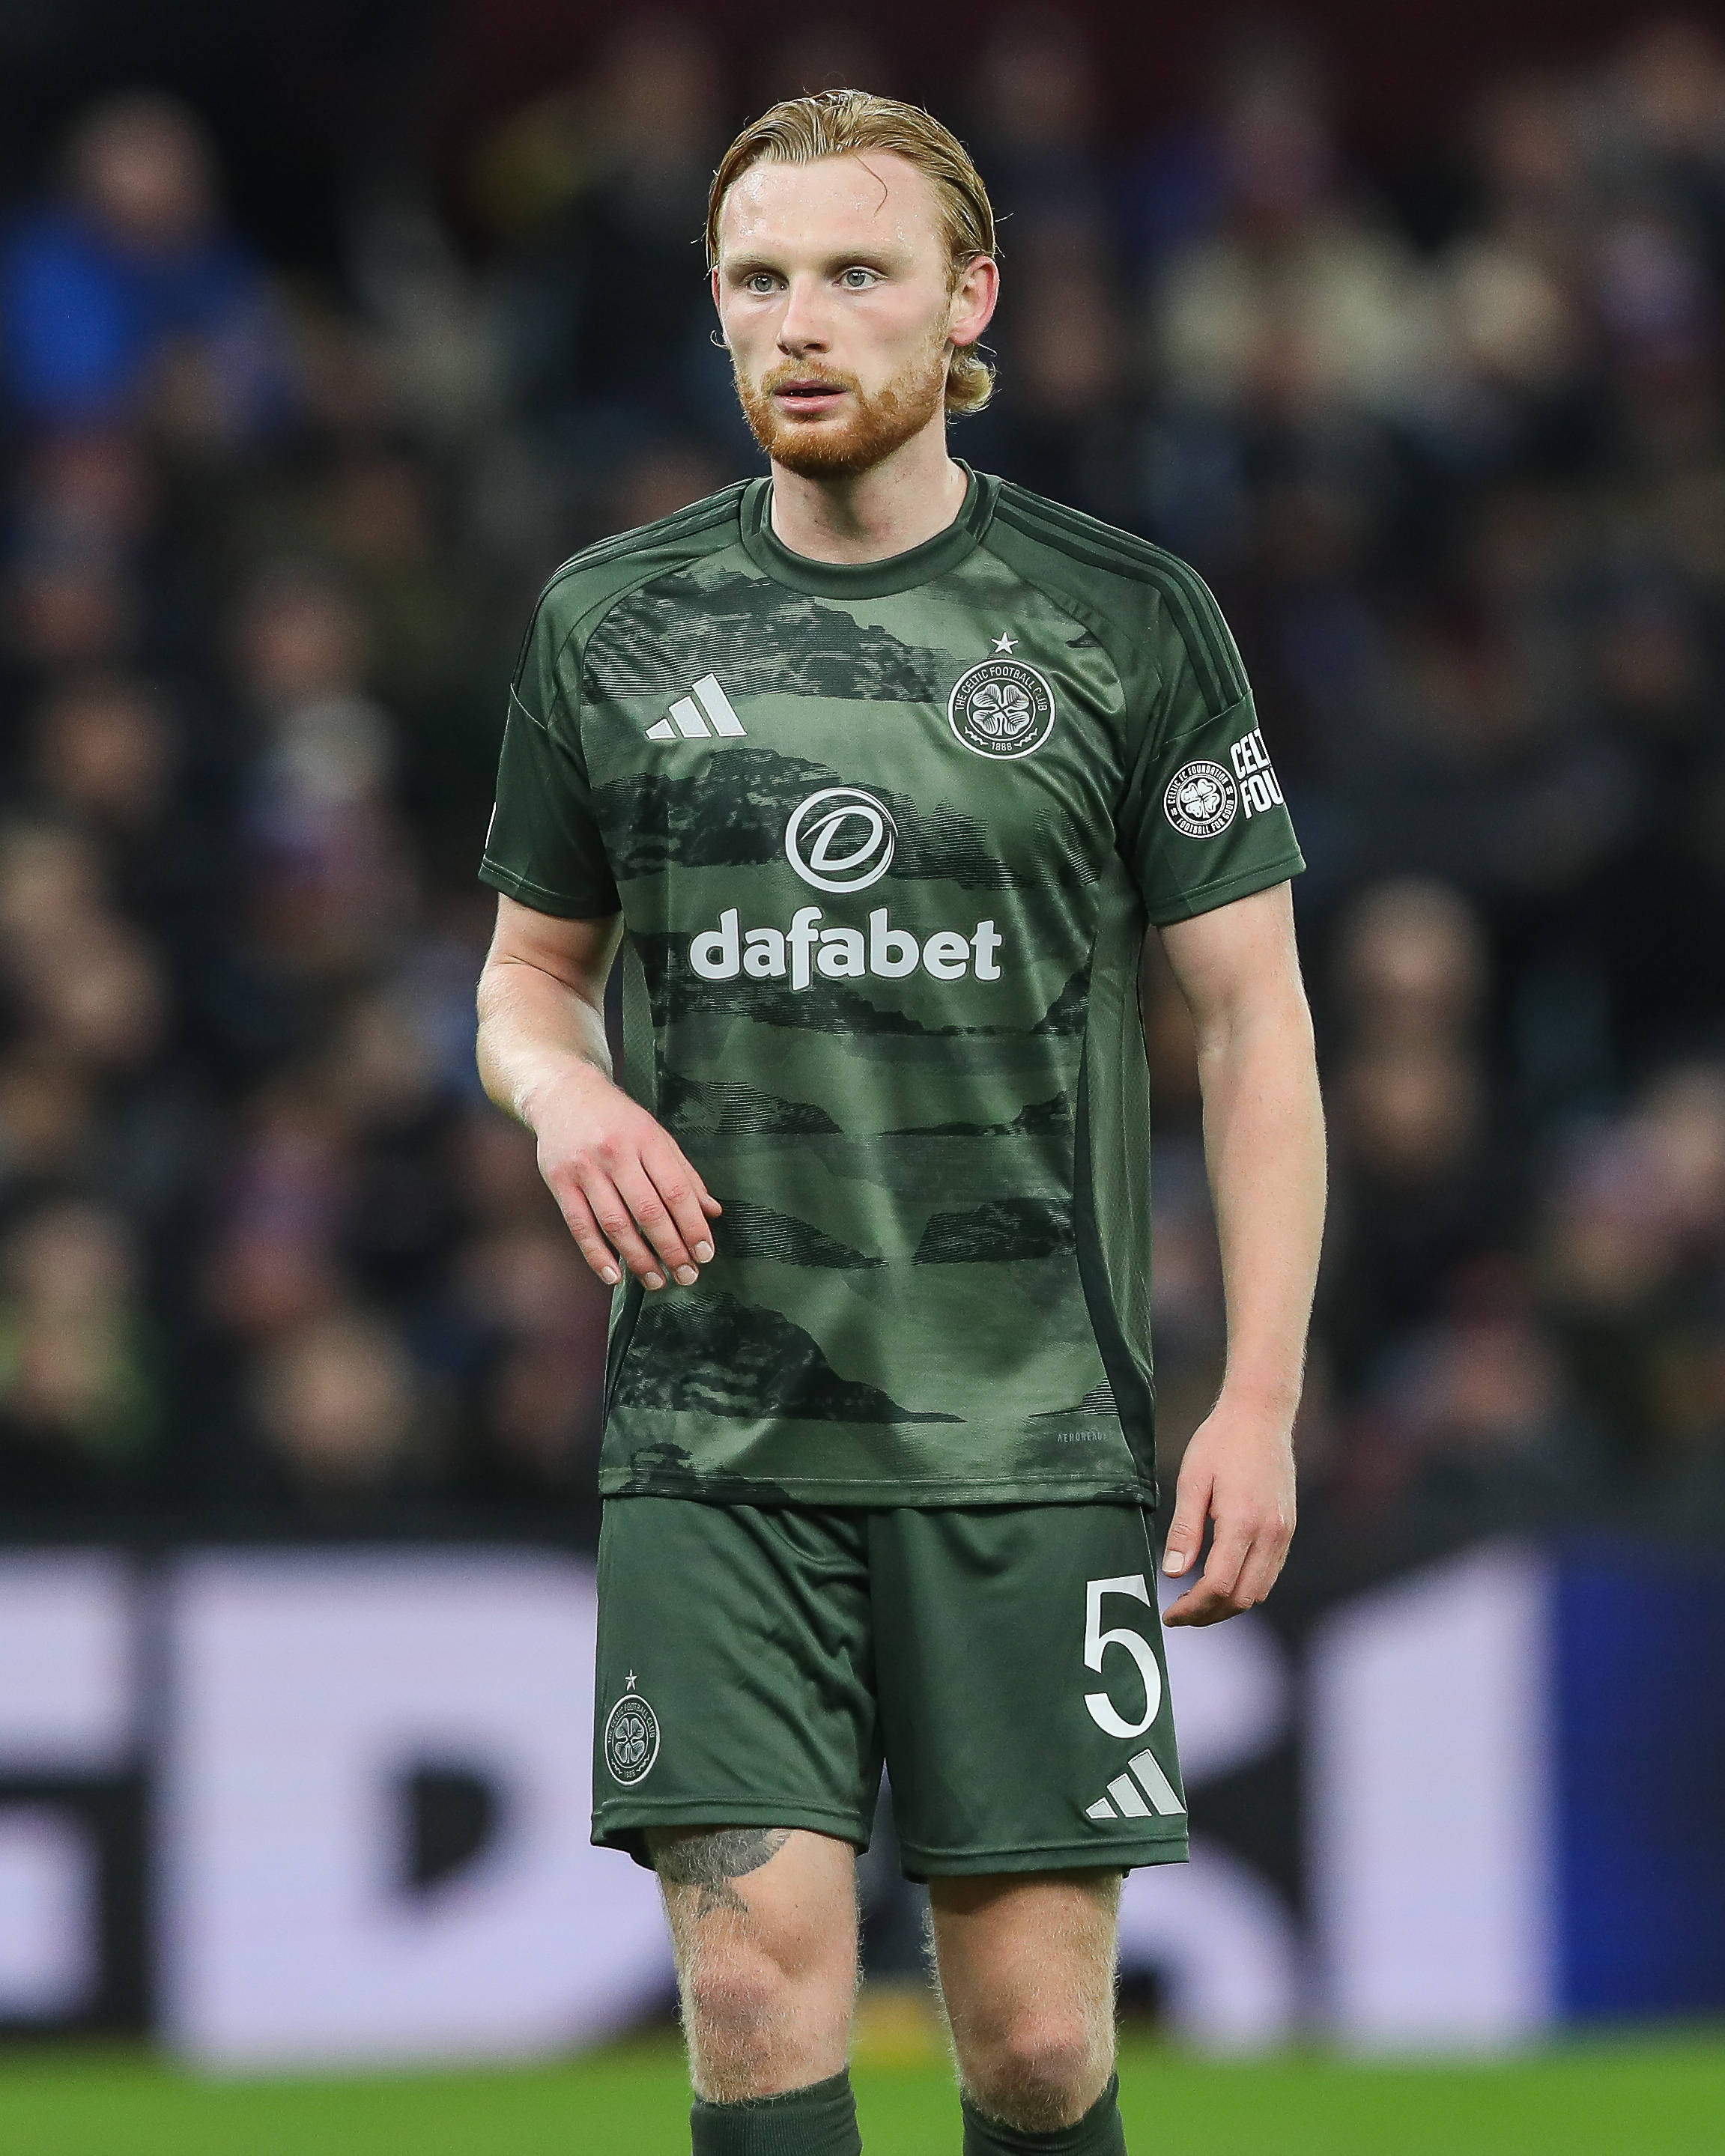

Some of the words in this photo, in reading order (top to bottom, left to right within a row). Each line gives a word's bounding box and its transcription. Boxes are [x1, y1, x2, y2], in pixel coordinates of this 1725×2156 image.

[955, 693, 967, 711] THE
[962, 669, 989, 693] CELTIC
[989, 666, 1036, 689] FOOTBALL
[1032, 687, 1048, 711] CLUB
[991, 742, 1013, 751] 1888
[1168, 780, 1181, 804] CELTIC
[1179, 771, 1188, 781] FC
[1188, 765, 1229, 784] FOUNDATION
[1176, 818, 1210, 834] FOOTBALL
[1210, 818, 1225, 832] FOR
[1222, 800, 1234, 820] GOOD
[690, 906, 1003, 991] dafabet
[1058, 1432, 1109, 1443] AEROREAD
[1084, 1574, 1161, 1739] 5
